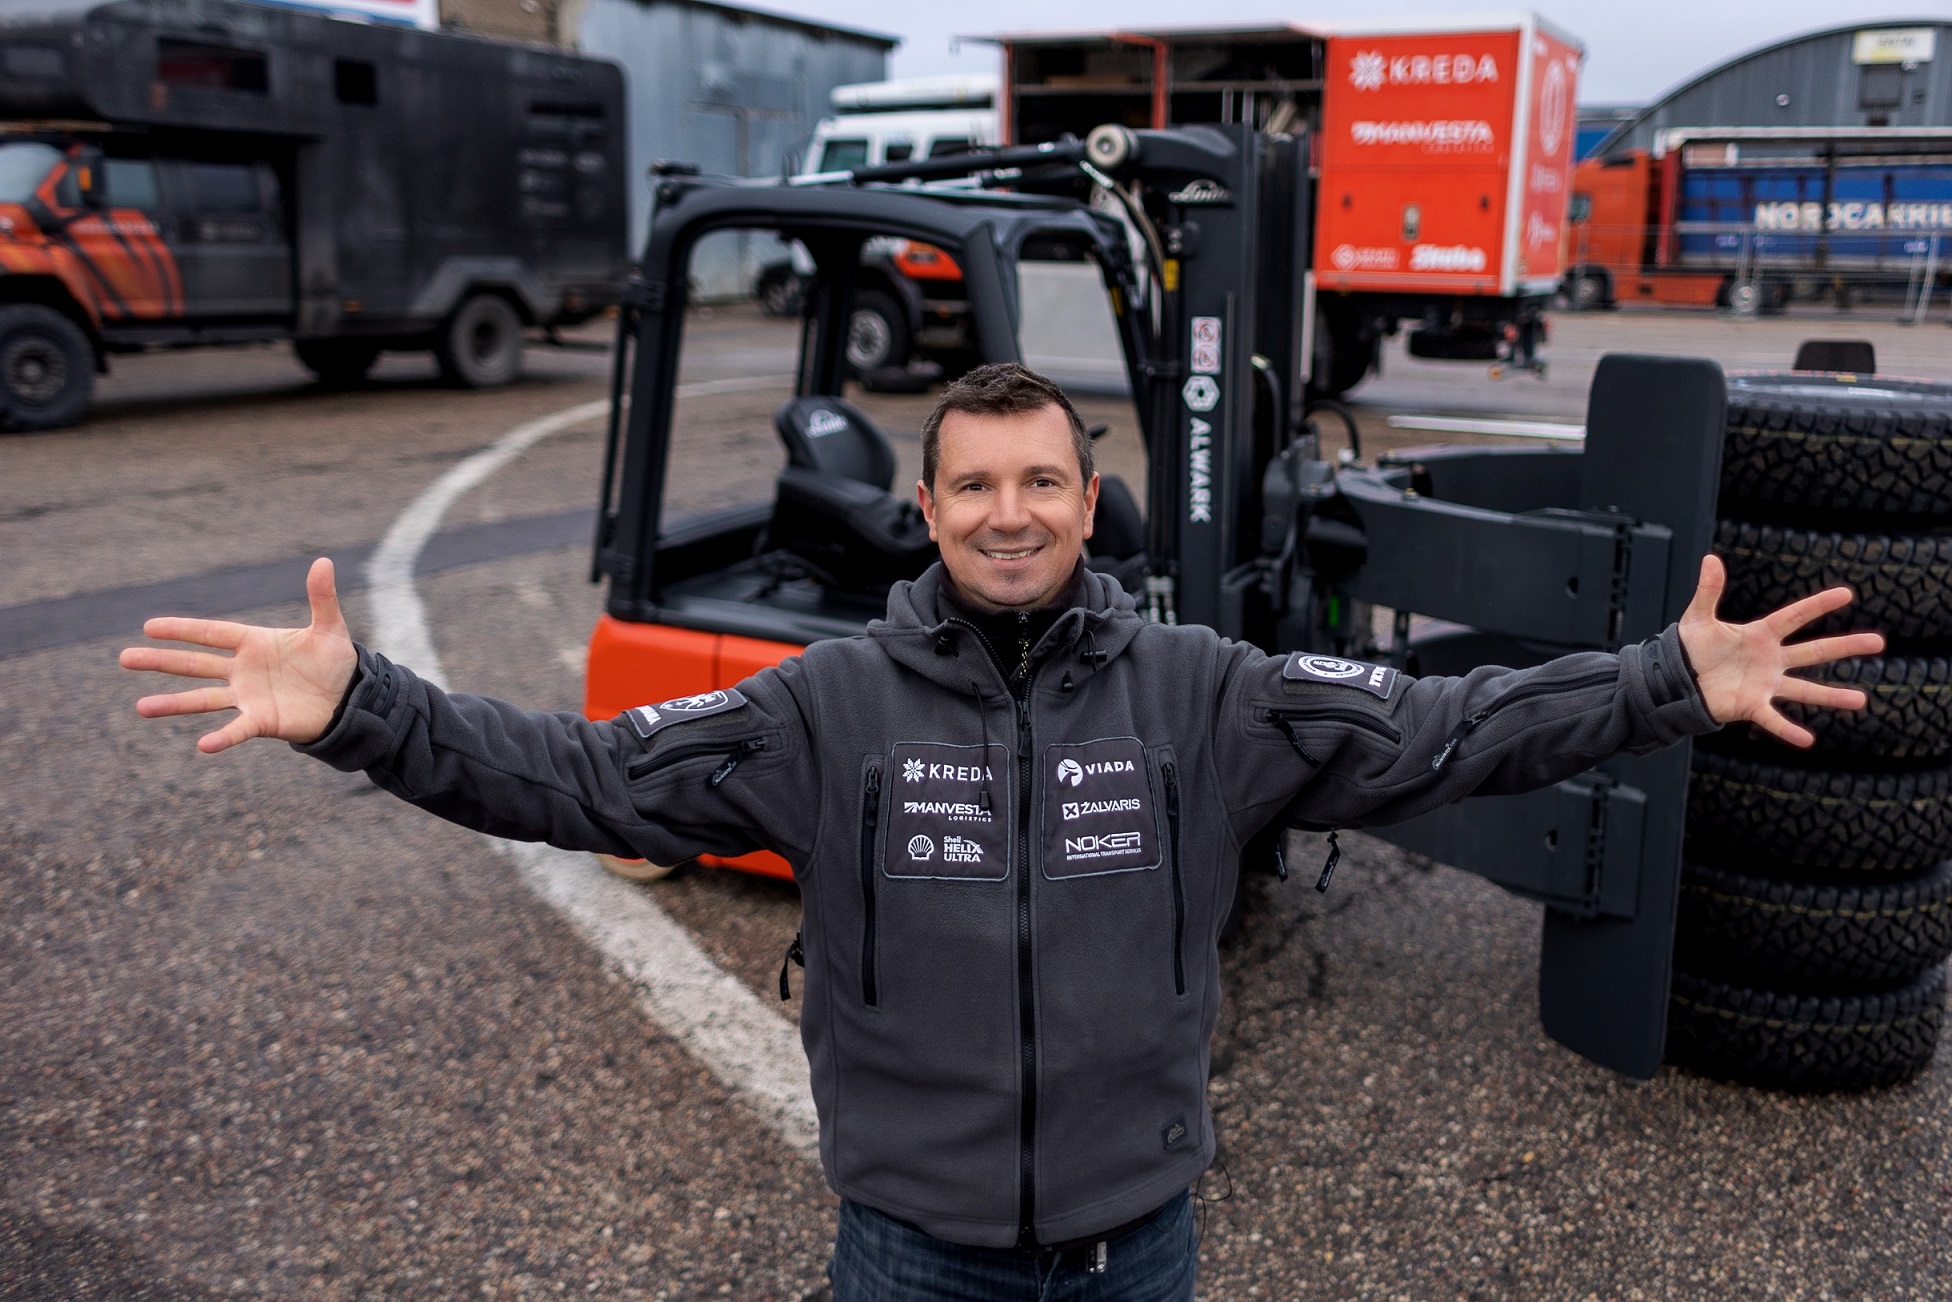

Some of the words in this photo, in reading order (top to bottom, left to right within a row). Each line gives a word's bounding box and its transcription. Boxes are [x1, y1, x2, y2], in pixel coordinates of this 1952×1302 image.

[1389, 53, 1499, 85] KREDA
[1190, 416, 1212, 523] ALWARK
[929, 763, 993, 781] KREDA
[1085, 760, 1135, 775] VIADA
[1081, 798, 1140, 815] ŽALVARIS
[943, 843, 984, 854] HELIX
[943, 853, 982, 862] ULTRA
